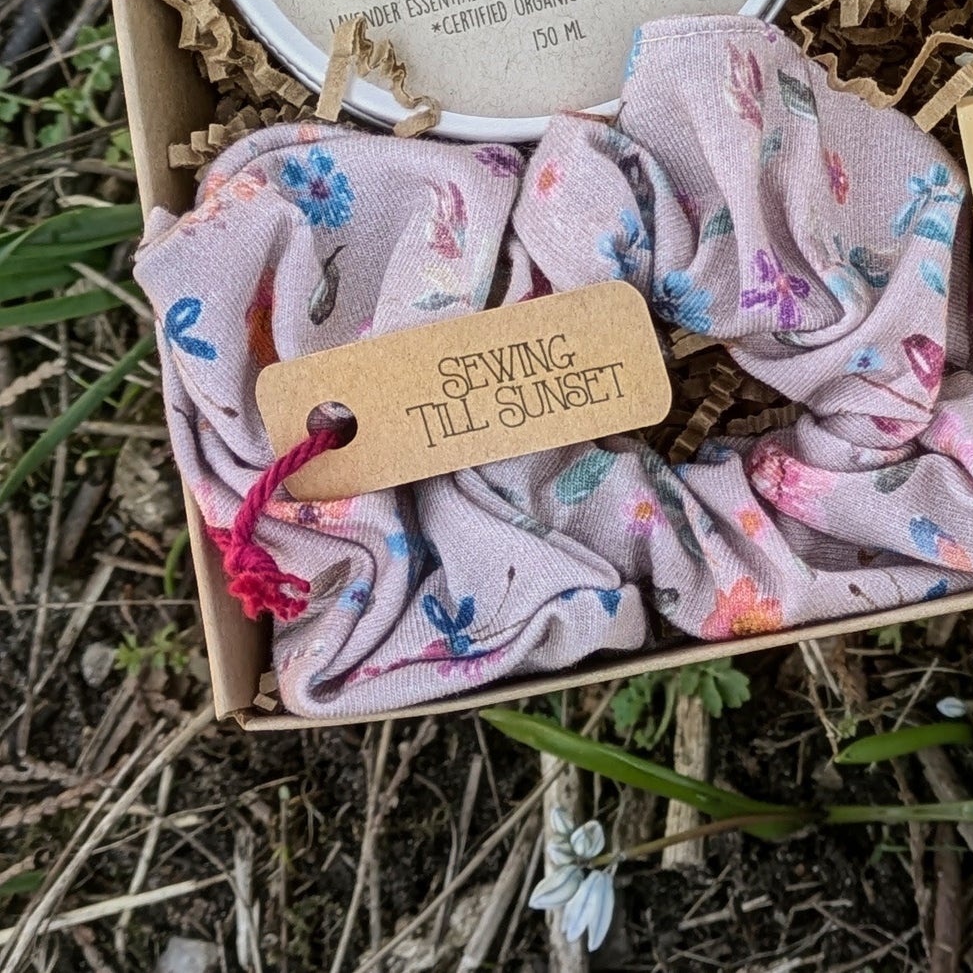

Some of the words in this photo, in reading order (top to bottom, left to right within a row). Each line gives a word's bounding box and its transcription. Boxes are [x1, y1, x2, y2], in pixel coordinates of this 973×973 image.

[532, 26, 559, 51] 150
[564, 19, 587, 42] ML
[437, 334, 577, 400] SEWING
[406, 397, 489, 448] TILL
[494, 362, 626, 429] SUNSET
